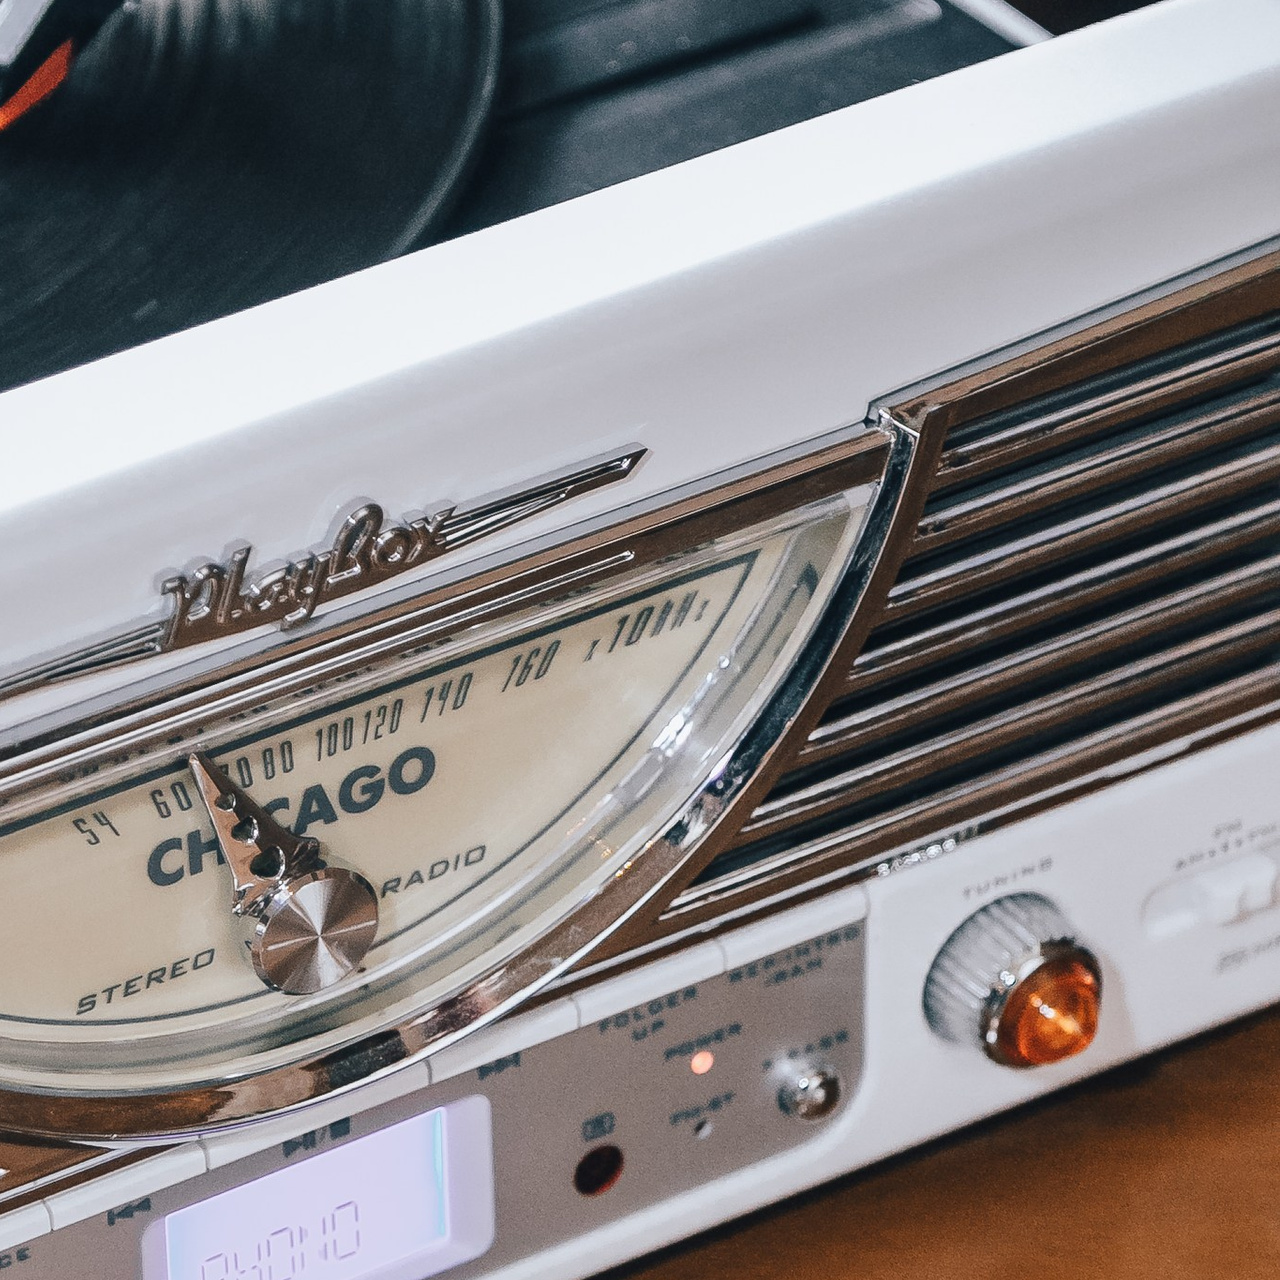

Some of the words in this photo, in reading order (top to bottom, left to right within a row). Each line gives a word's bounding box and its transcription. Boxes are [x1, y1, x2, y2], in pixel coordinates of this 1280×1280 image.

[71, 810, 121, 847] 54
[149, 780, 193, 819] 60
[262, 739, 295, 780] 80
[315, 716, 354, 762] 100
[362, 698, 404, 745] 120
[420, 671, 474, 724] 140
[501, 639, 562, 693] 160
[147, 746, 436, 887] CHCAGO
[380, 844, 487, 900] RADIO
[962, 855, 1055, 901] TUNING
[75, 948, 216, 1017] STEREO
